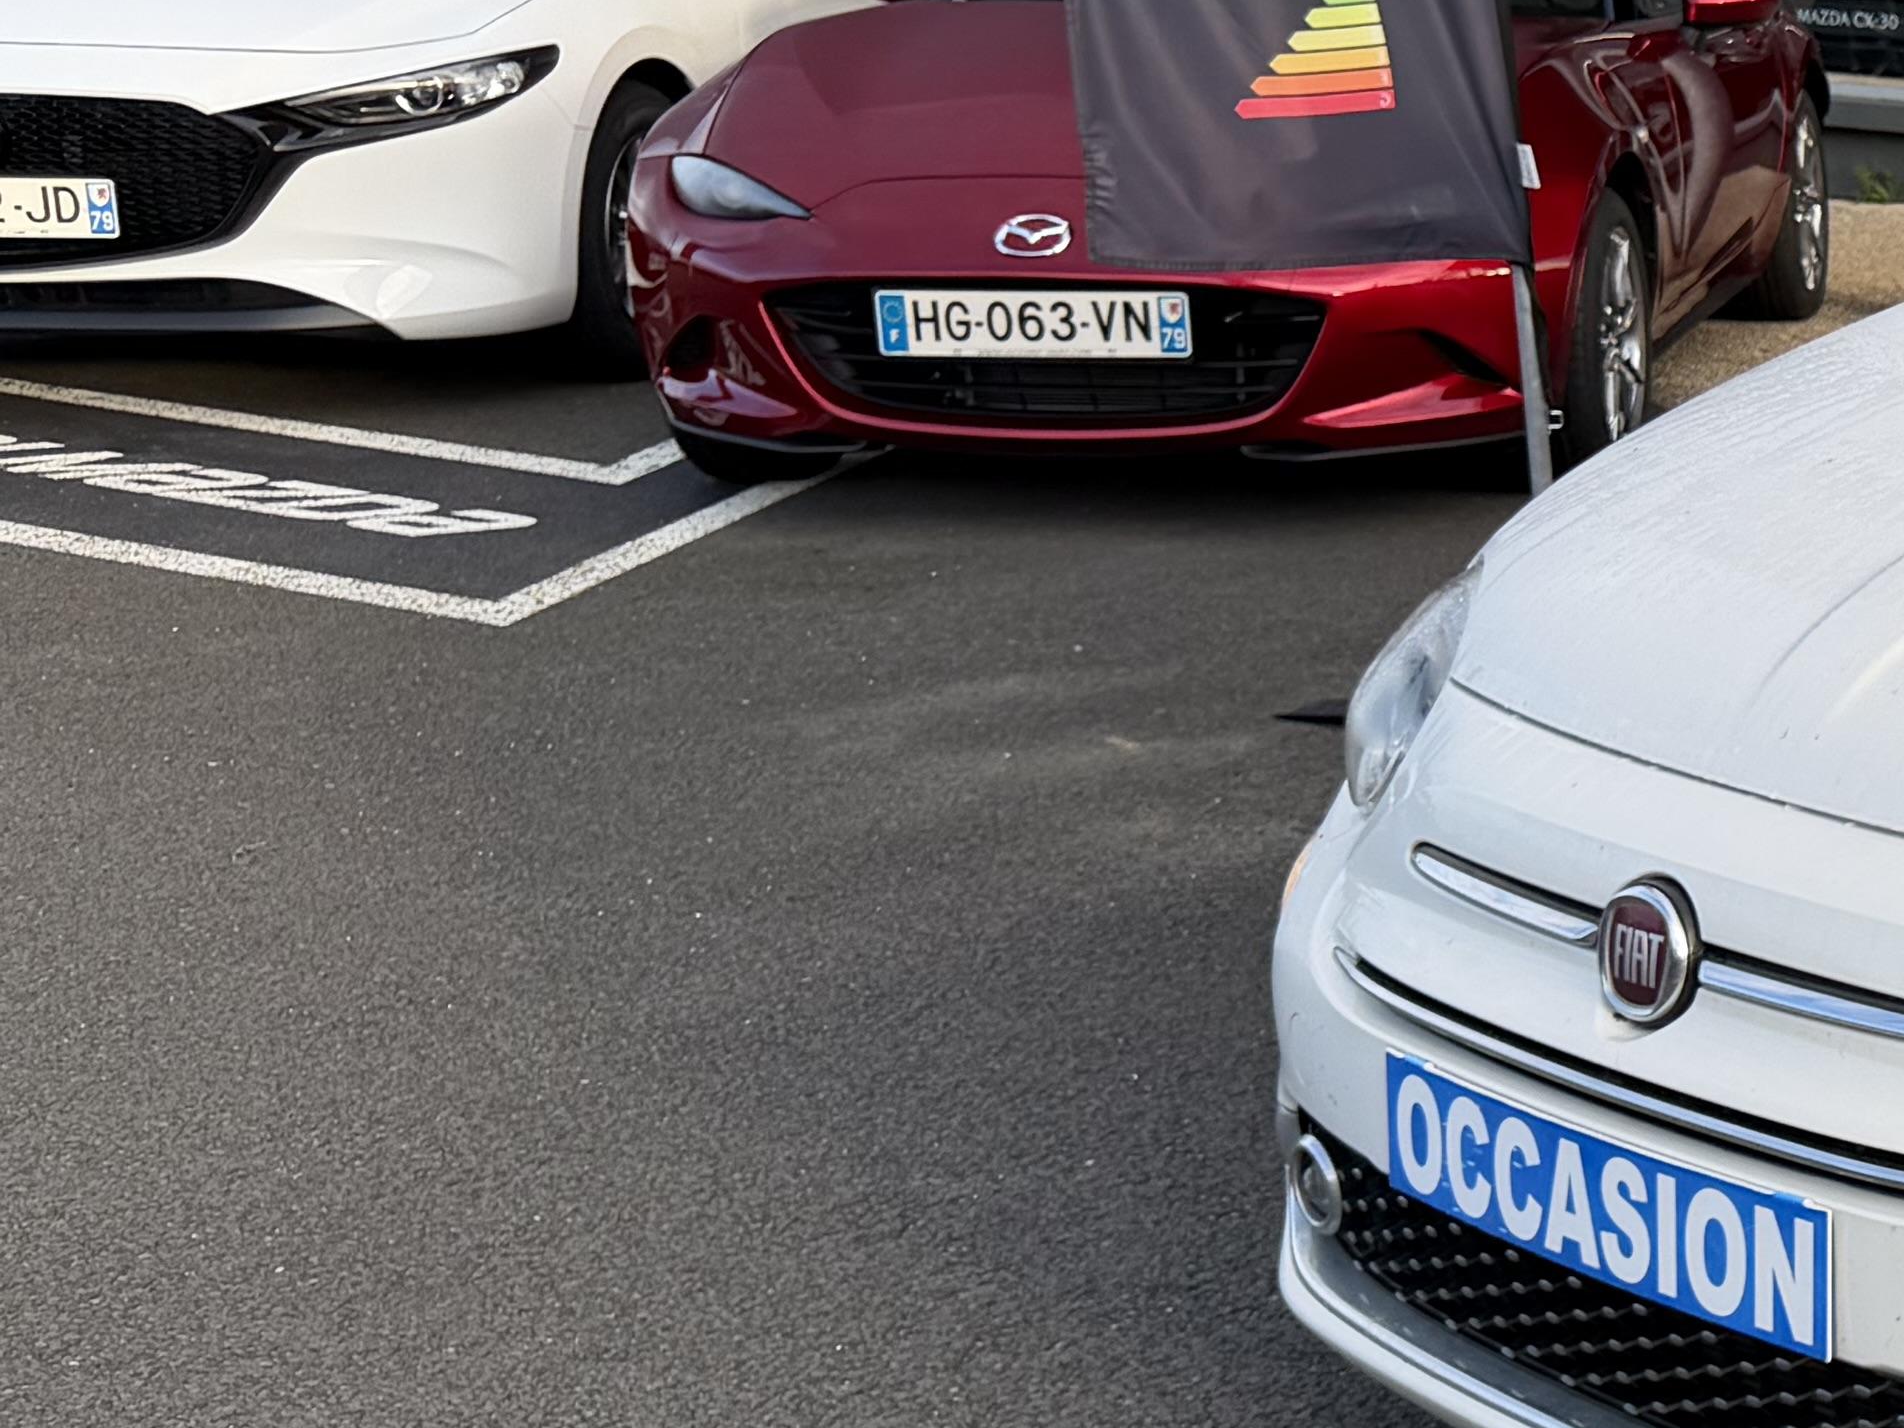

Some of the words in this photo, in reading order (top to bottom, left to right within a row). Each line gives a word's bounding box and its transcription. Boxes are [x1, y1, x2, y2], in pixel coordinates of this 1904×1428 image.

[1797, 8, 1852, 27] MAZDA
[90, 210, 114, 231] 79
[911, 300, 1153, 342] HG-063-VN
[1162, 327, 1185, 350] 79
[1613, 922, 1665, 990] FIAT
[1396, 1073, 1815, 1348] OCCASION
